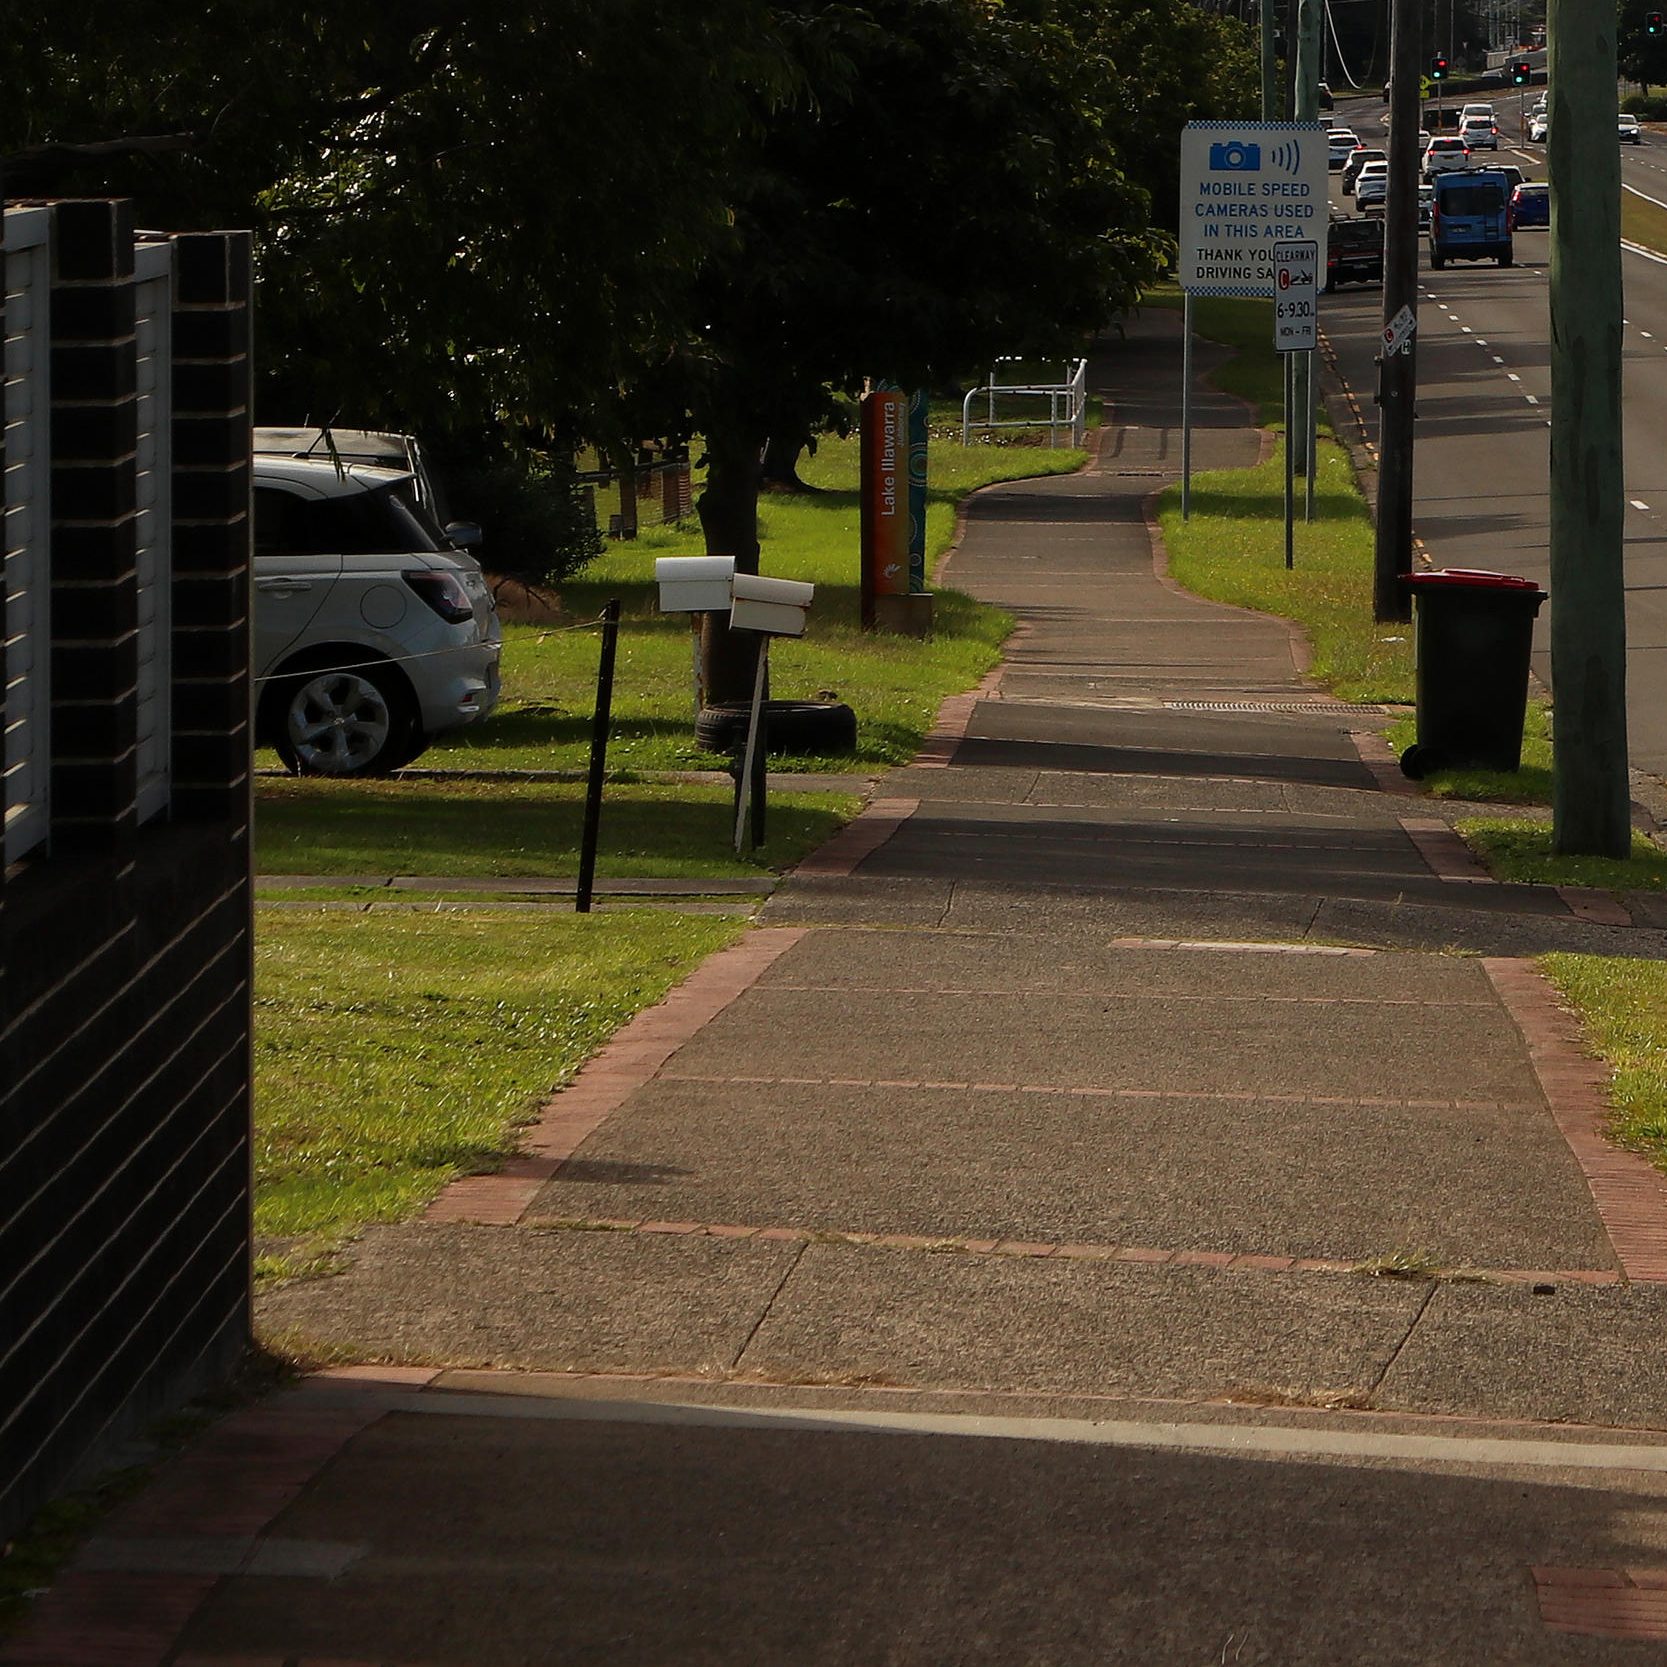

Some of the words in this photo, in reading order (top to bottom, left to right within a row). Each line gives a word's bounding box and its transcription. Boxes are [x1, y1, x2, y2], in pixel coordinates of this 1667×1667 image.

[1200, 183, 1256, 196] MOBILE
[1262, 184, 1309, 196] SPEED
[1195, 204, 1268, 217] CAMERAS
[1274, 205, 1313, 218] USED
[1204, 225, 1218, 237] IN
[1225, 225, 1258, 238] THIS
[1264, 225, 1304, 238] AREA
[1197, 248, 1242, 261] THANK
[1249, 249, 1274, 261] YOU
[1277, 251, 1315, 262] CLEARWAY
[1197, 267, 1251, 279] DRIVING
[881, 402, 896, 471] Illawarra
[881, 477, 896, 516] Lake
